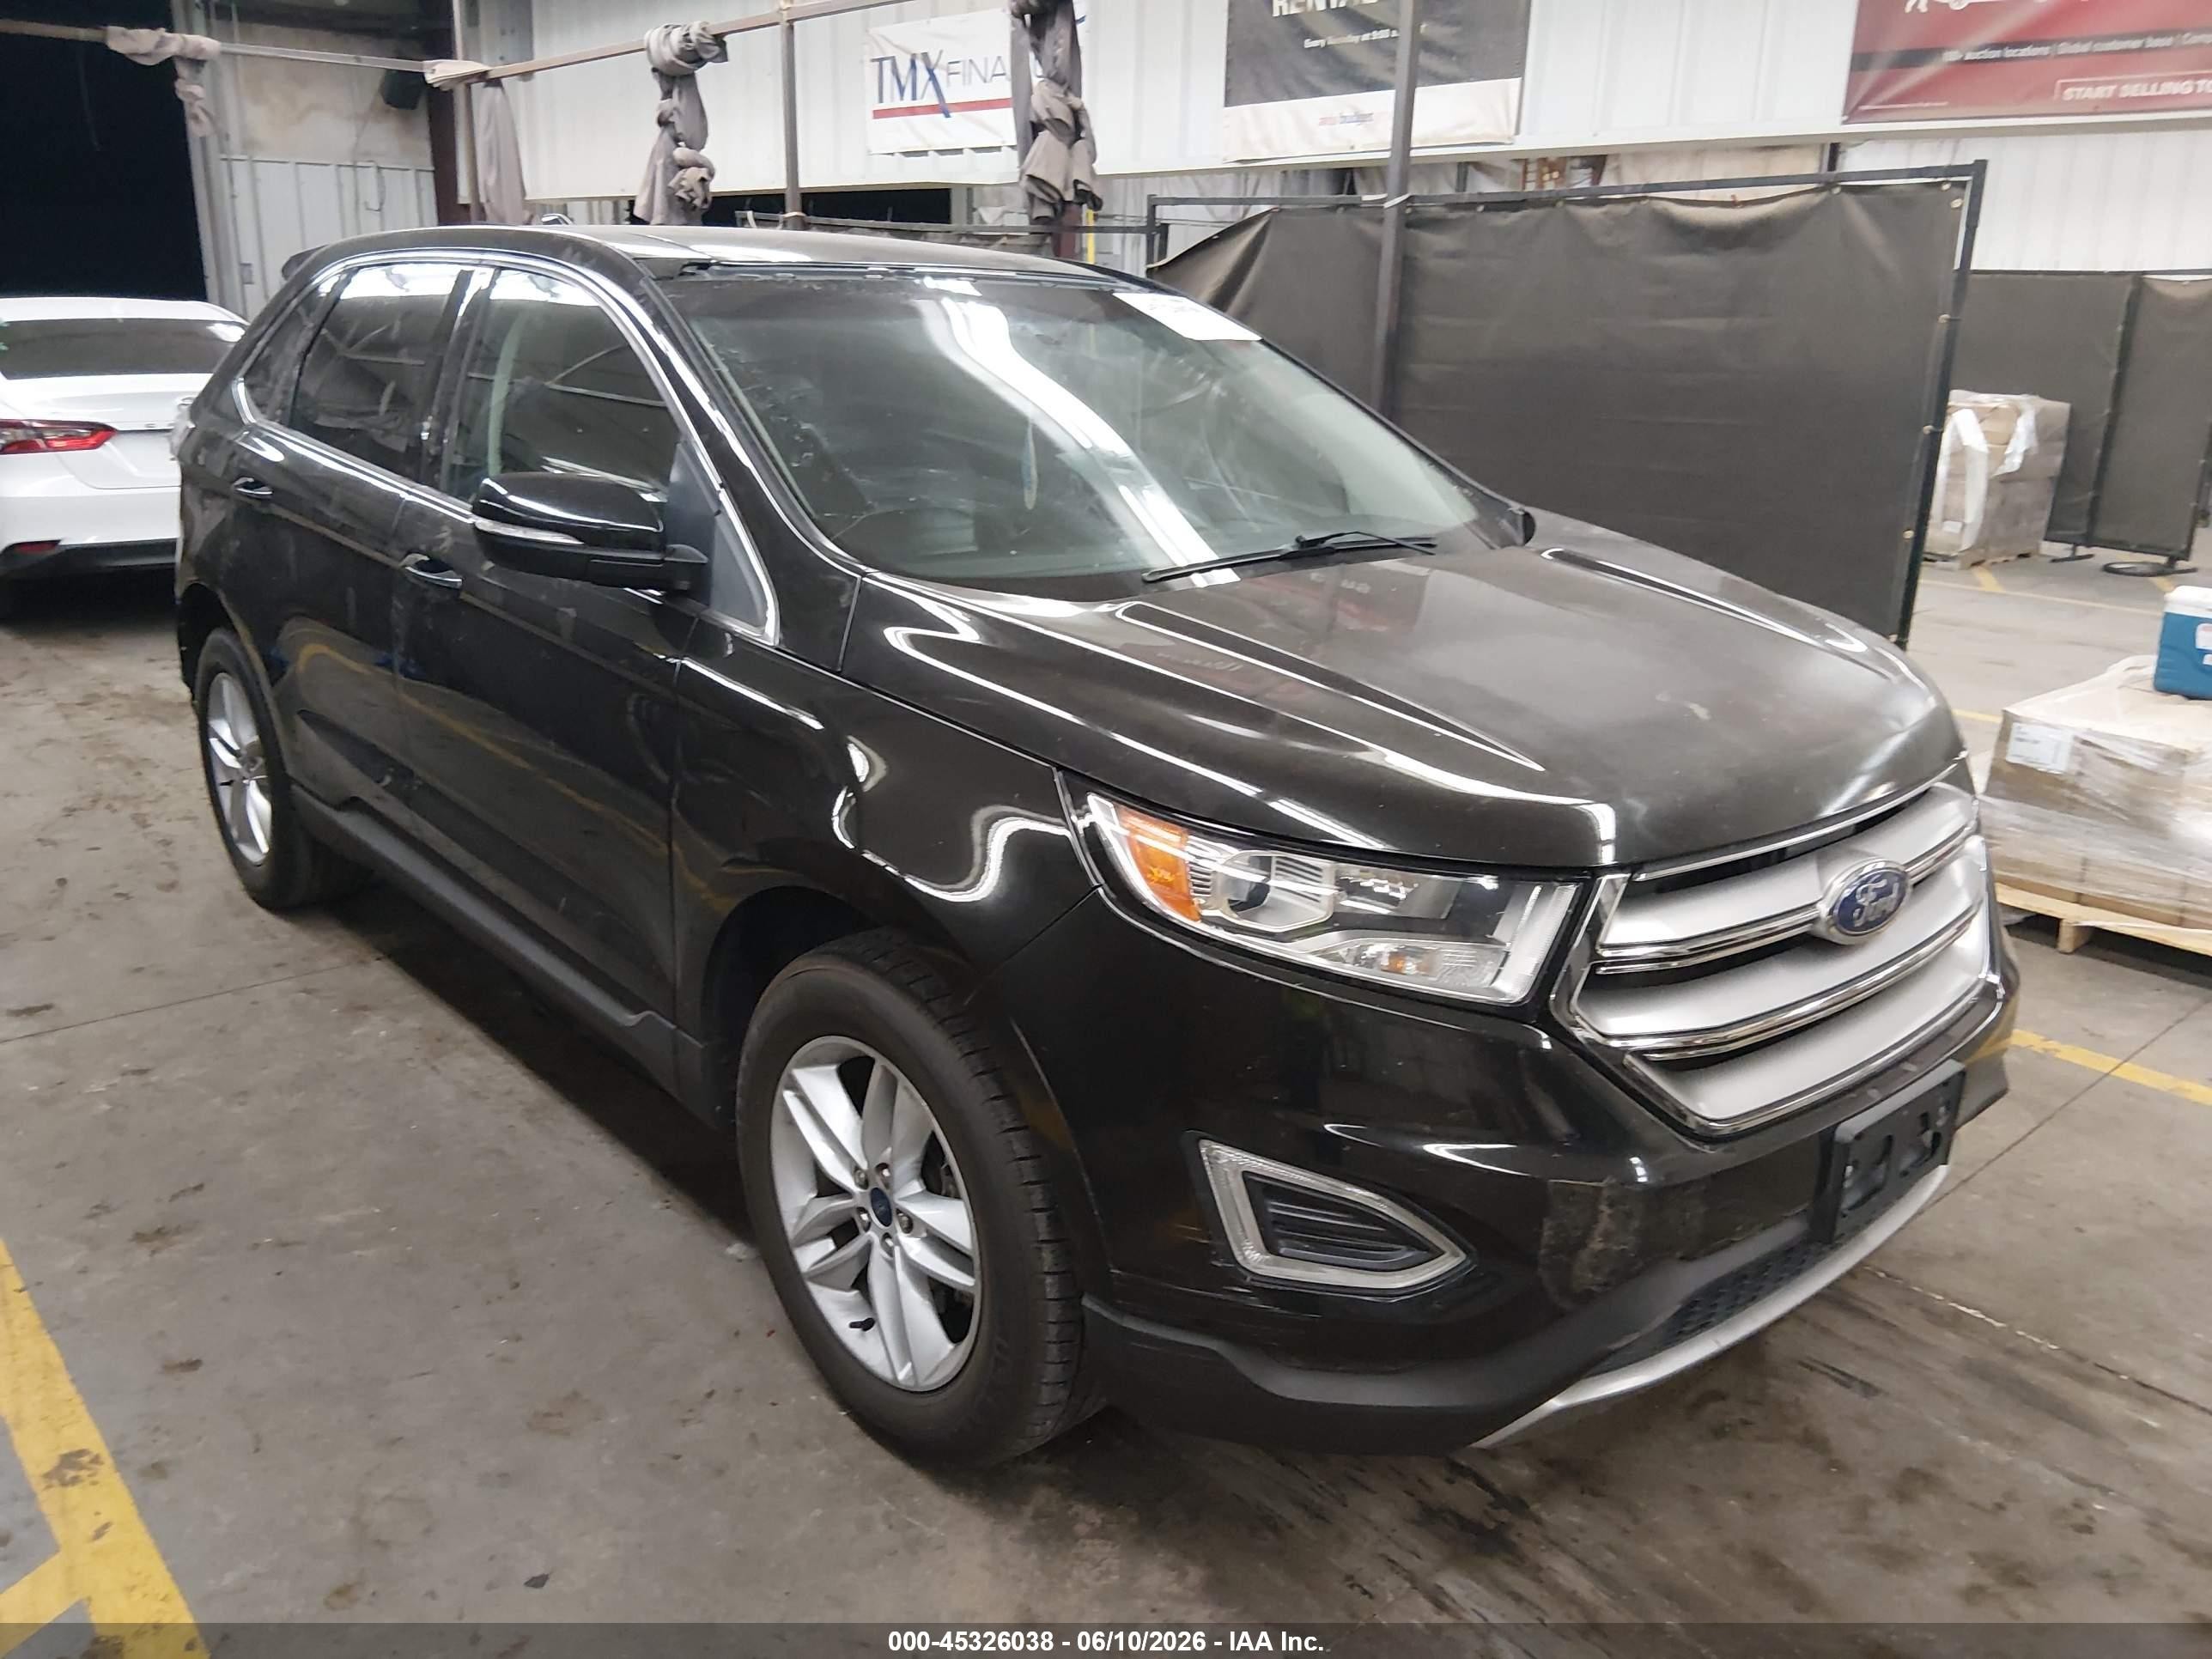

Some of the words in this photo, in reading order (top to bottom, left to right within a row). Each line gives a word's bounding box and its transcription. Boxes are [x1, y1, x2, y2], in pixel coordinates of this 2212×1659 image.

[871, 49, 951, 118] TMX
[947, 55, 1012, 87] FINA
[2062, 84, 2118, 101] START
[2118, 79, 2195, 98] SELLING
[1852, 874, 1900, 927] Ford
